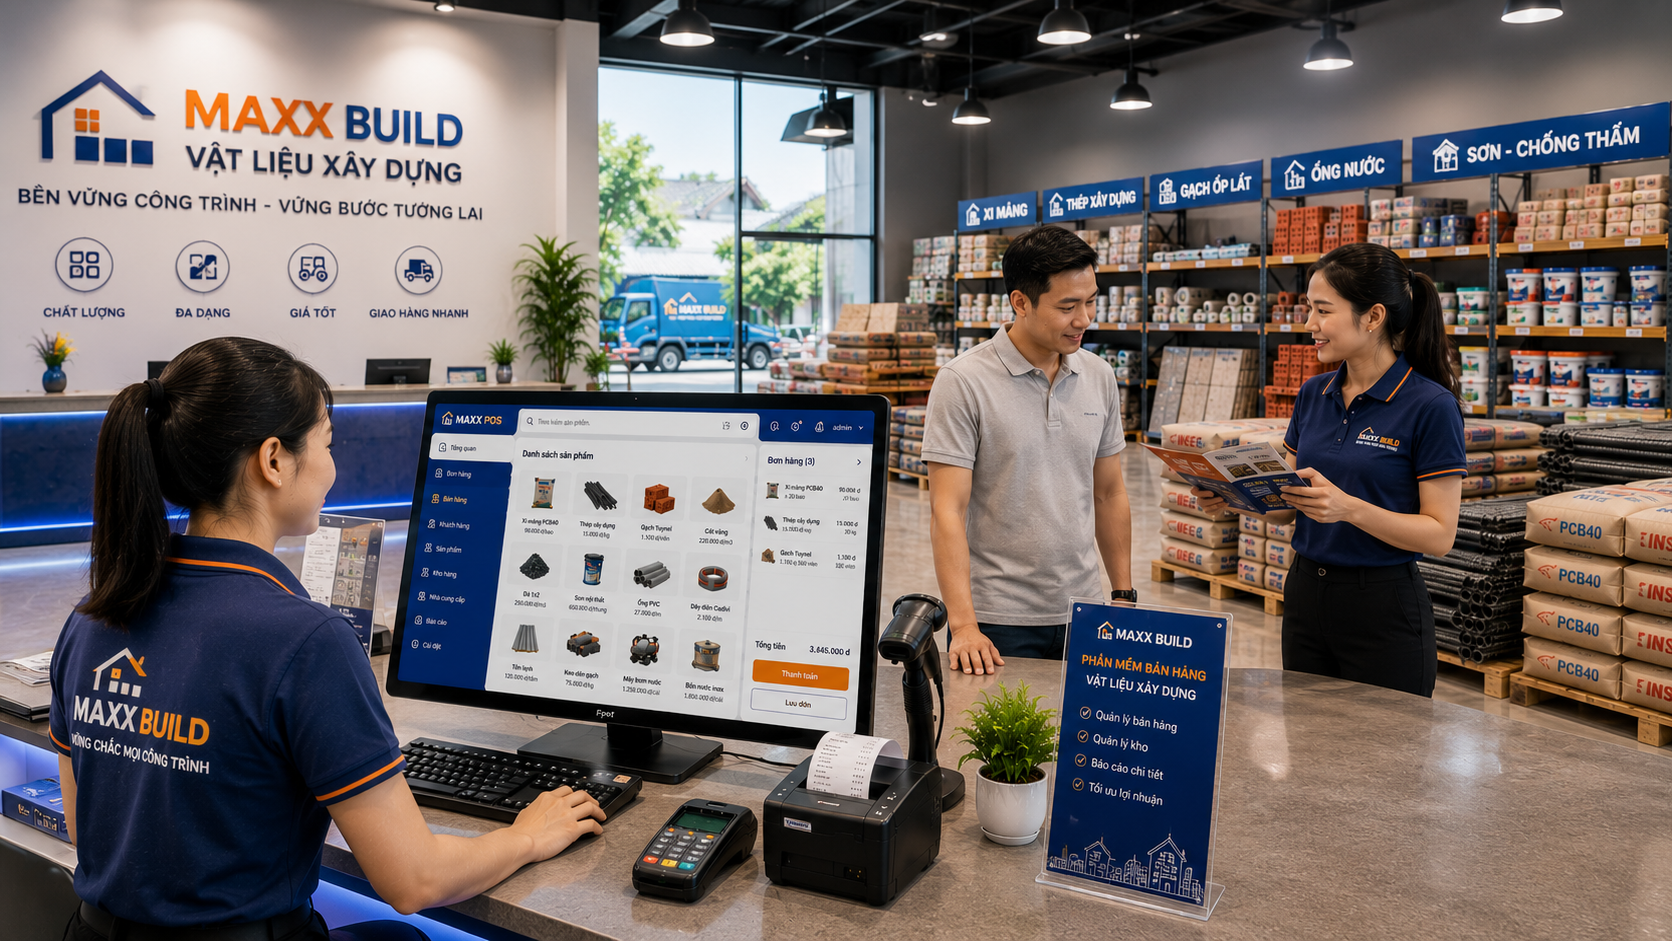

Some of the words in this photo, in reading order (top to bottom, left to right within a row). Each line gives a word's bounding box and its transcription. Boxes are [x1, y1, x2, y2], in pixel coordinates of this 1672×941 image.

[185, 88, 334, 139] MAXX
[346, 104, 464, 147] BUILD
[1467, 143, 1501, 164] SƠN
[1516, 130, 1580, 158] CHỐNG
[186, 142, 243, 176] VẬT
[254, 146, 313, 180] LIỆU
[322, 151, 377, 177] XÂY
[386, 158, 462, 187] DỰNG
[1311, 160, 1341, 182] ỐNG
[1344, 155, 1385, 178] NƯỚC
[1180, 181, 1211, 200] GẠCH
[135, 190, 193, 210] CÔNG
[199, 194, 256, 212] TRÌNH
[459, 207, 483, 220] LAI
[983, 207, 994, 221] XI
[82, 306, 126, 320] LƯỢNG
[176, 308, 193, 318] ĐA
[196, 308, 231, 320] DẠNG
[290, 306, 310, 318] GIÁ
[370, 309, 396, 318] GIAO
[432, 309, 469, 319] NHANH
[456, 416, 482, 425] MAXX
[484, 416, 503, 425] POS
[522, 450, 540, 458] Danh
[805, 457, 816, 467] (3)
[1560, 520, 1602, 540] PCB40
[1559, 568, 1601, 589] PCB40
[1557, 615, 1600, 637] PCB40
[1116, 628, 1153, 644] MAXX
[1155, 633, 1193, 649] BUILD
[1557, 659, 1600, 682] PCB40
[1162, 685, 1197, 701] DỰNG
[73, 695, 139, 733] MAXX
[139, 708, 210, 746] BUILD
[123, 745, 141, 763] MỌI
[1130, 740, 1149, 752] kho
[1130, 766, 1146, 777] chi
[1119, 788, 1131, 801] lợi
